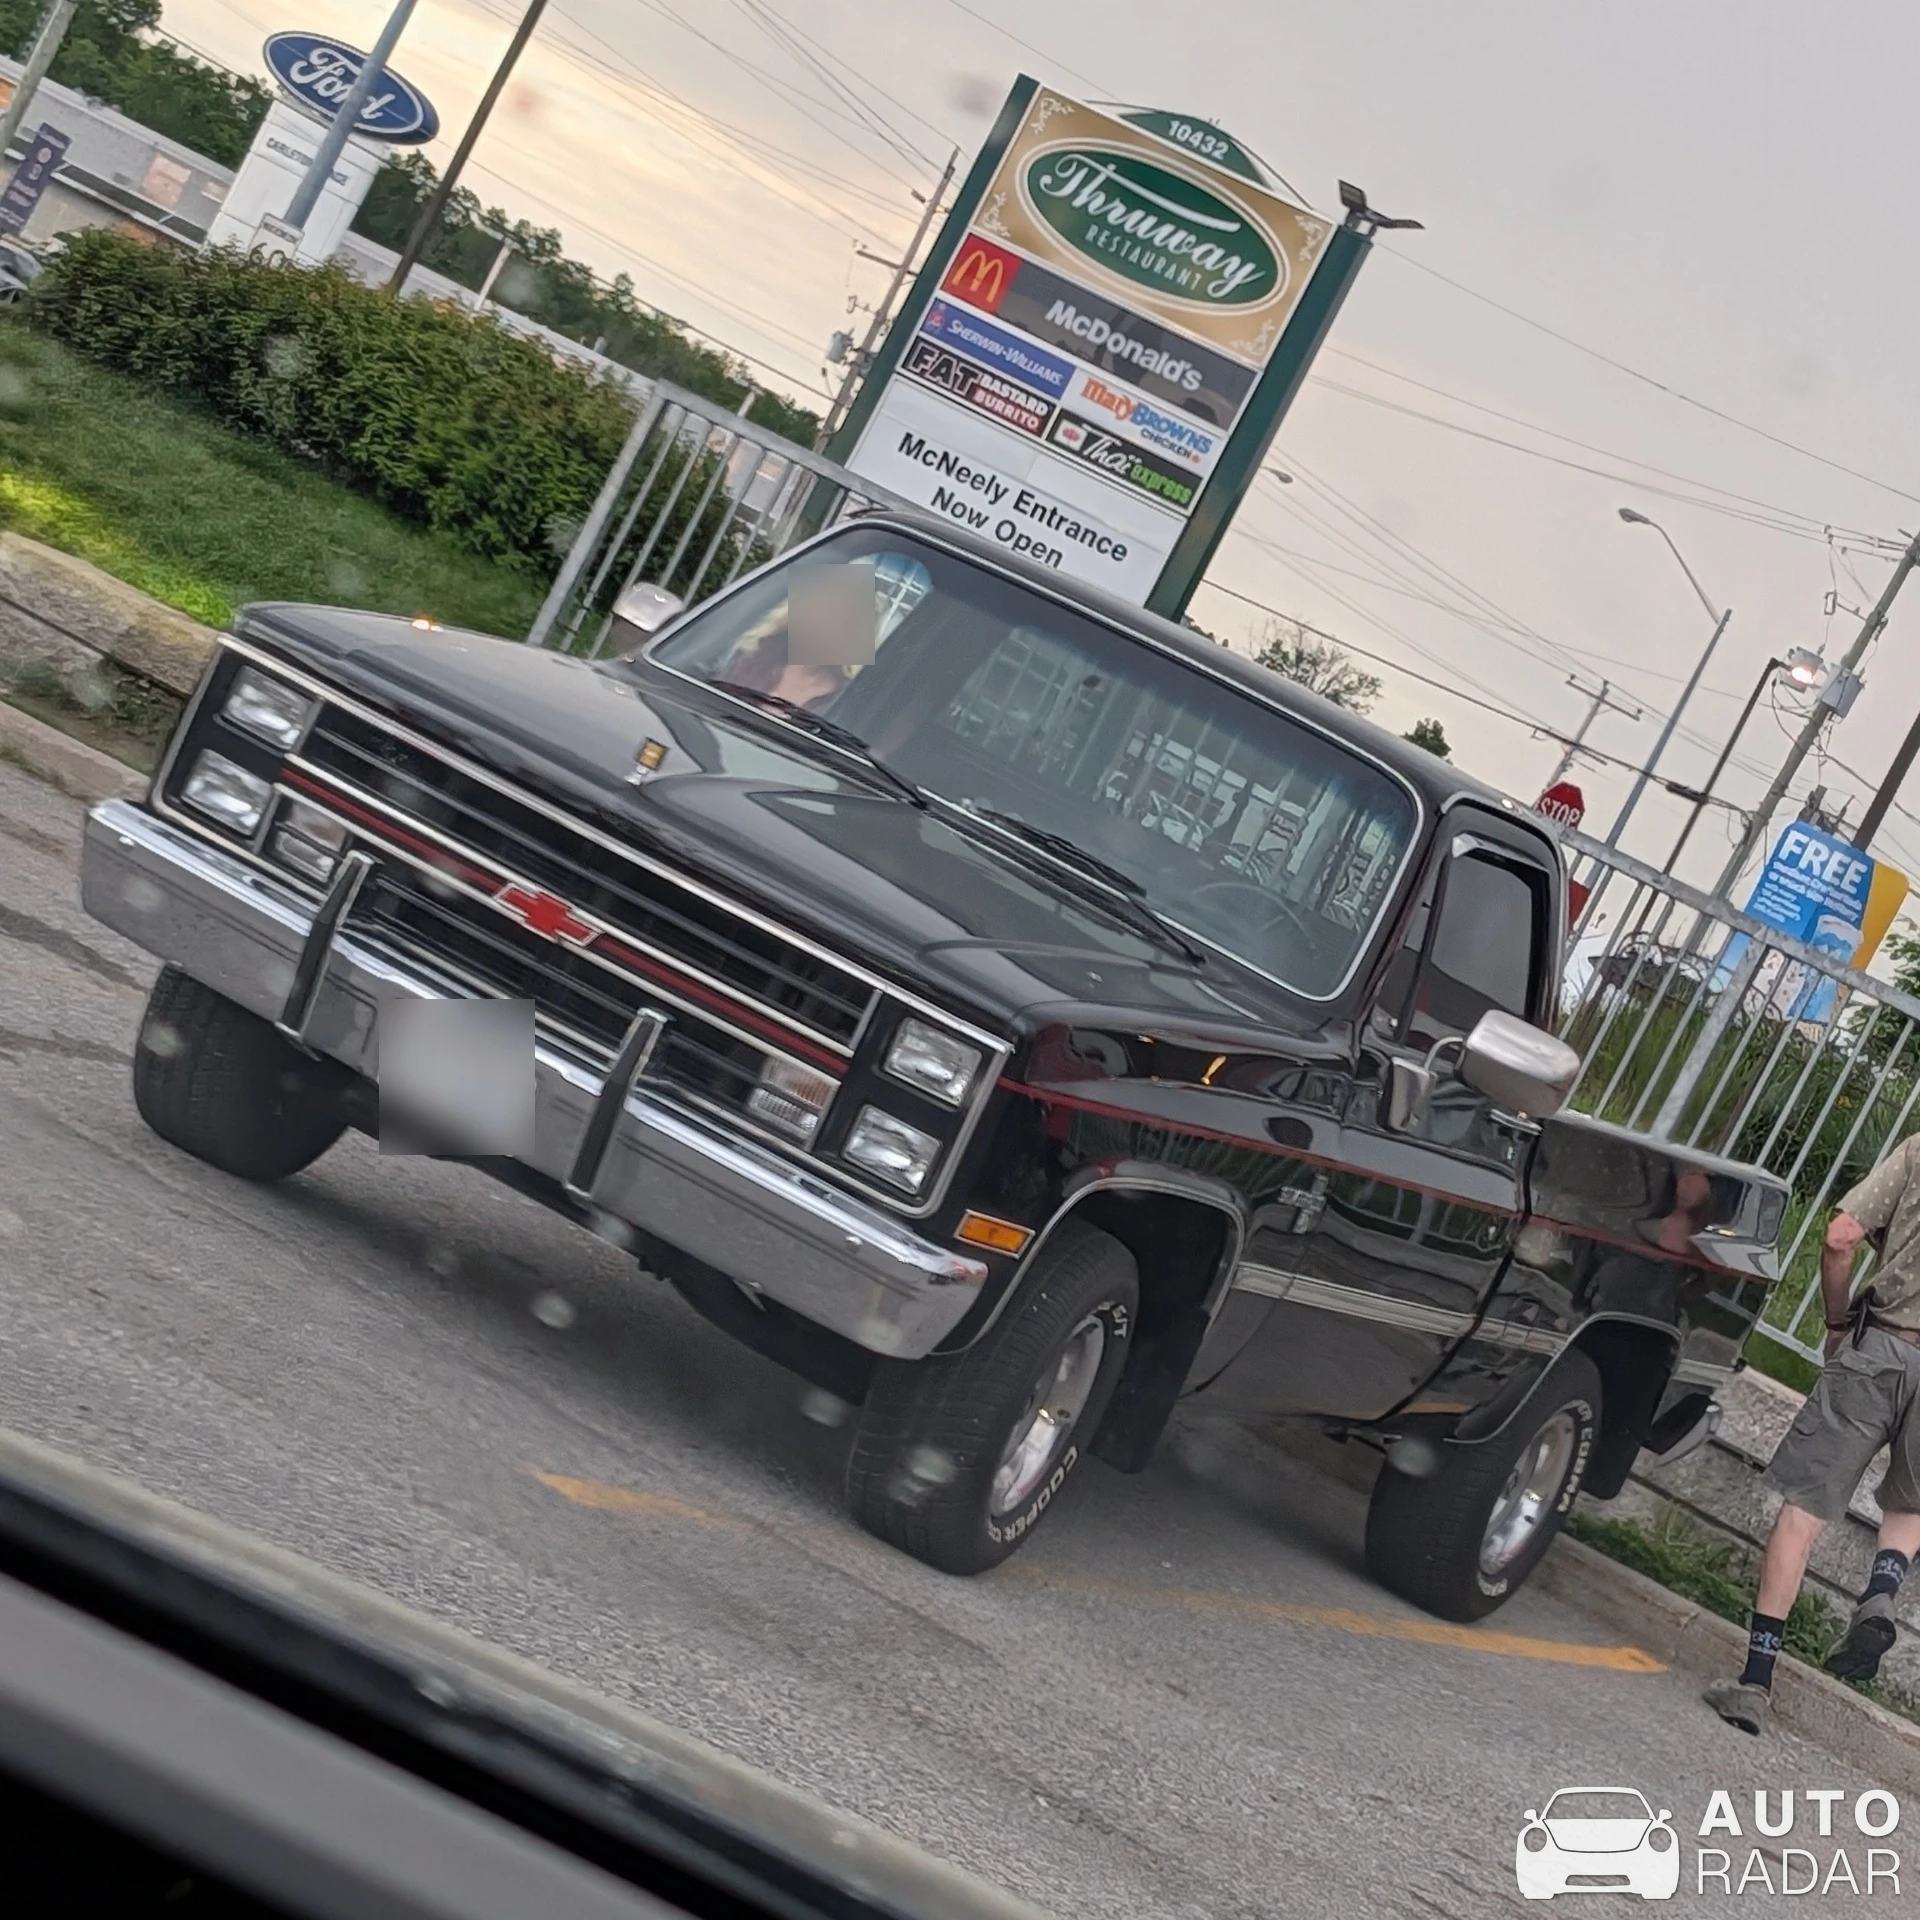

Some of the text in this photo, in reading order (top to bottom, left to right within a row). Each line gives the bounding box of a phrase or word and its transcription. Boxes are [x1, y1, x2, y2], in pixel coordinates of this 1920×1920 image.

[1168, 120, 1230, 161] 10432
[1039, 153, 1267, 298] Thruway
[1085, 224, 1202, 291] RESTAURANT
[909, 341, 1049, 416] FAT BASTARD
[1044, 299, 1203, 392] McDonald's
[973, 389, 1040, 431] BURRITO
[1140, 428, 1192, 461] CHICKEN
[898, 432, 1127, 562] McNeely Entrance
[1130, 462, 1193, 504] express
[930, 486, 1063, 568] Now Open
[1540, 797, 1580, 827] STOP
[1778, 829, 1869, 895] FREE
[1004, 1446, 1079, 1542] COOPER
